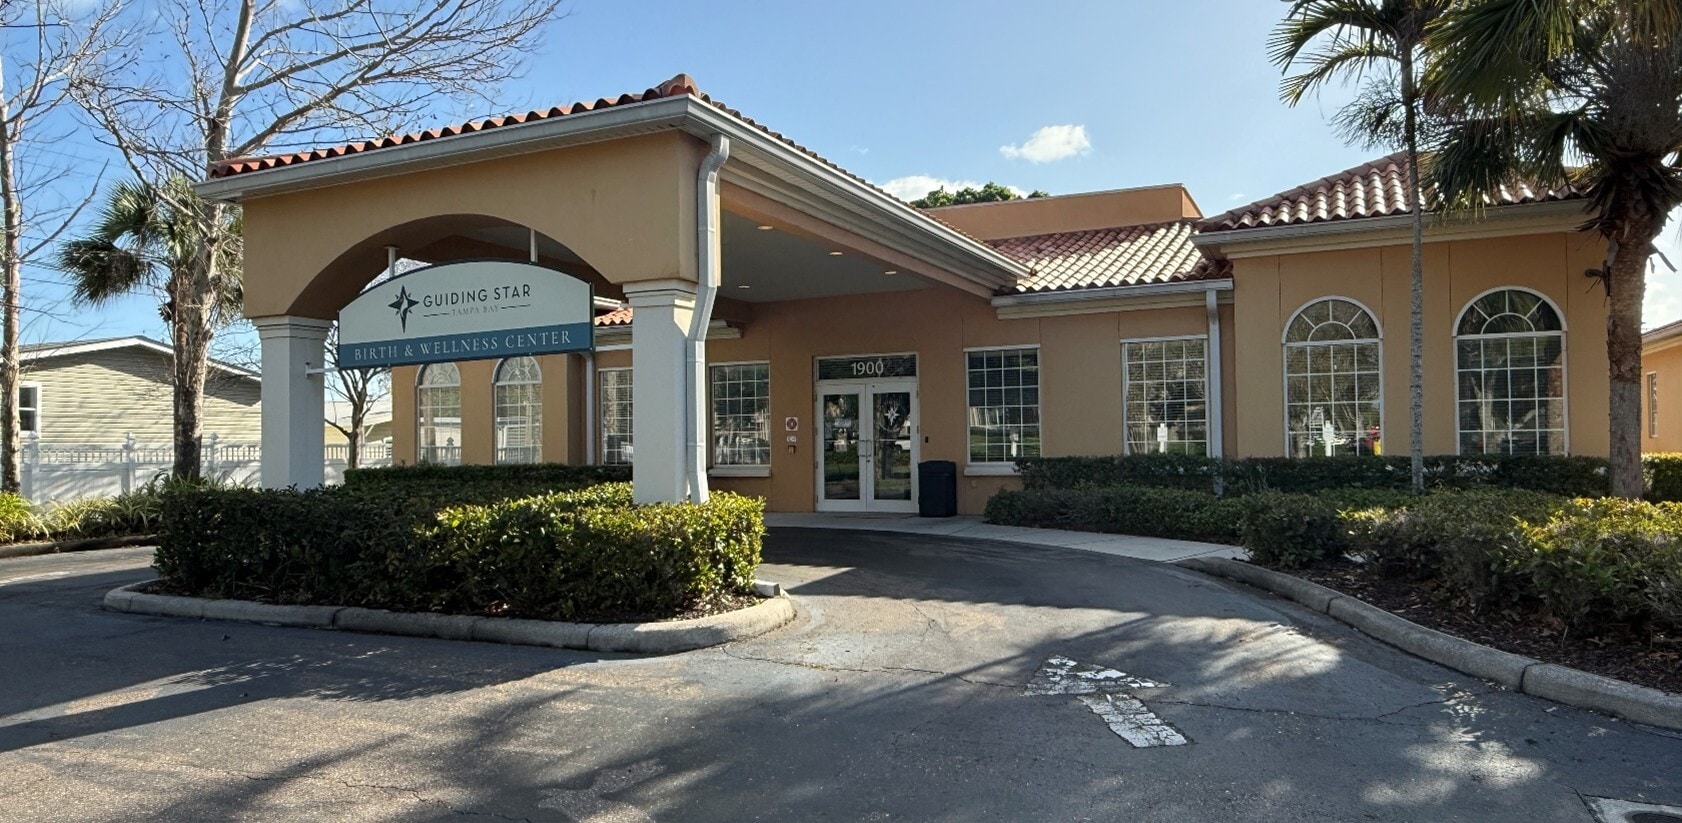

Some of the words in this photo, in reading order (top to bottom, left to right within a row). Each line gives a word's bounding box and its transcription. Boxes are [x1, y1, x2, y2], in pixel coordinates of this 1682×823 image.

[423, 288, 488, 308] GUIDING
[493, 284, 531, 300] STAR
[451, 306, 480, 316] TAMPA
[483, 305, 500, 314] BAY
[354, 345, 398, 361] BIRTH
[404, 344, 414, 356] &
[420, 337, 498, 356] WELLNESS
[505, 330, 571, 348] CENTER
[851, 361, 883, 375] 1900
